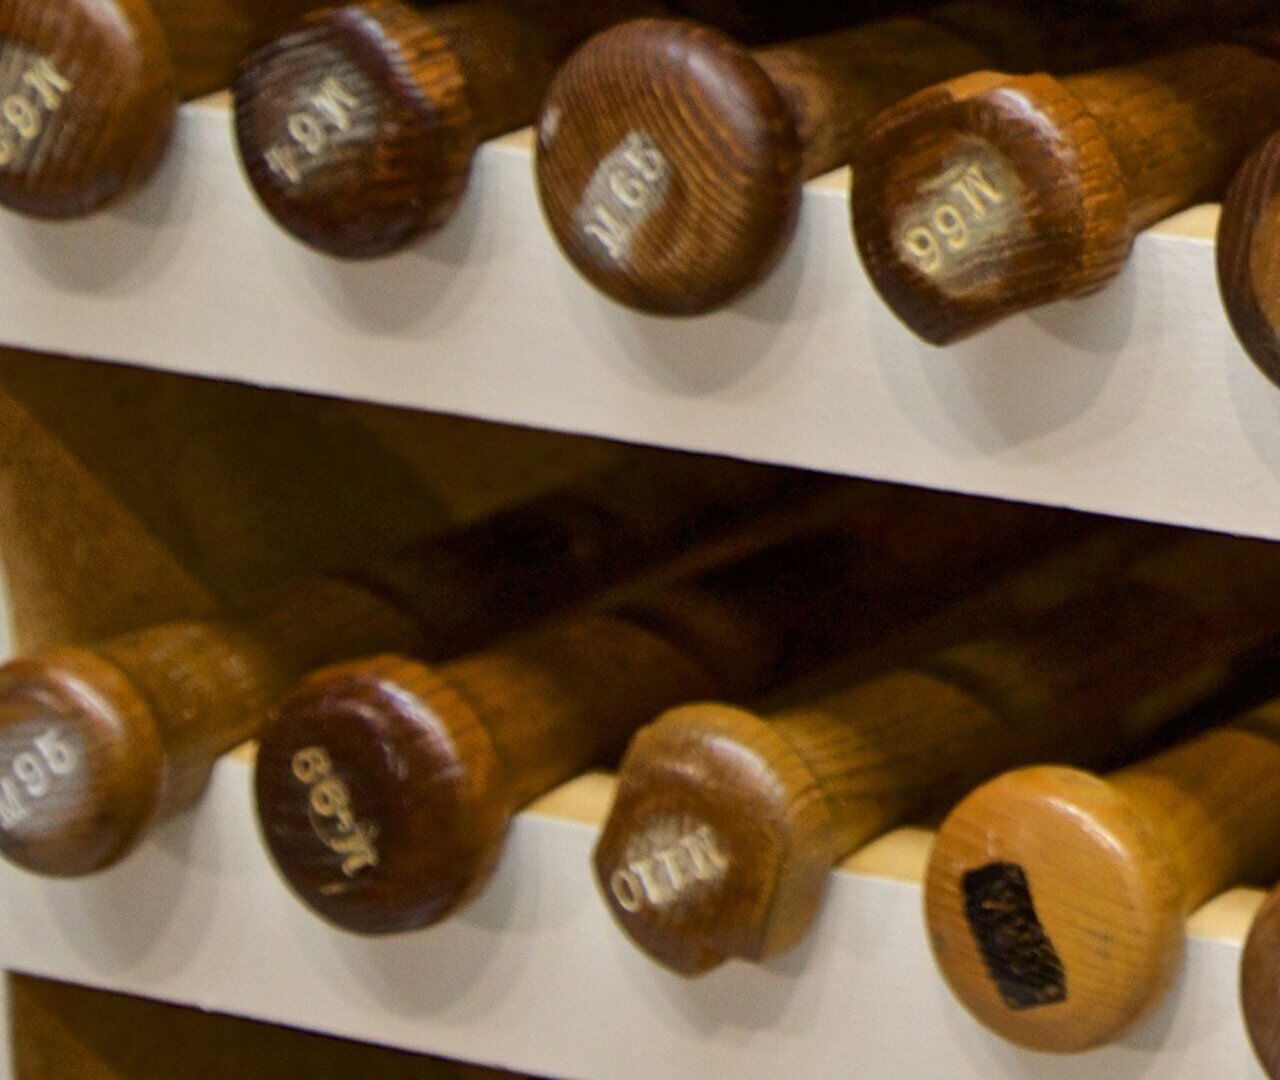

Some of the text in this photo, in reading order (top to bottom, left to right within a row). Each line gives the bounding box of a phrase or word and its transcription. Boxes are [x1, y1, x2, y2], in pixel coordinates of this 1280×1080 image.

[585, 135, 667, 260] M65
[905, 165, 1003, 274] M66
[610, 822, 730, 913] M110
